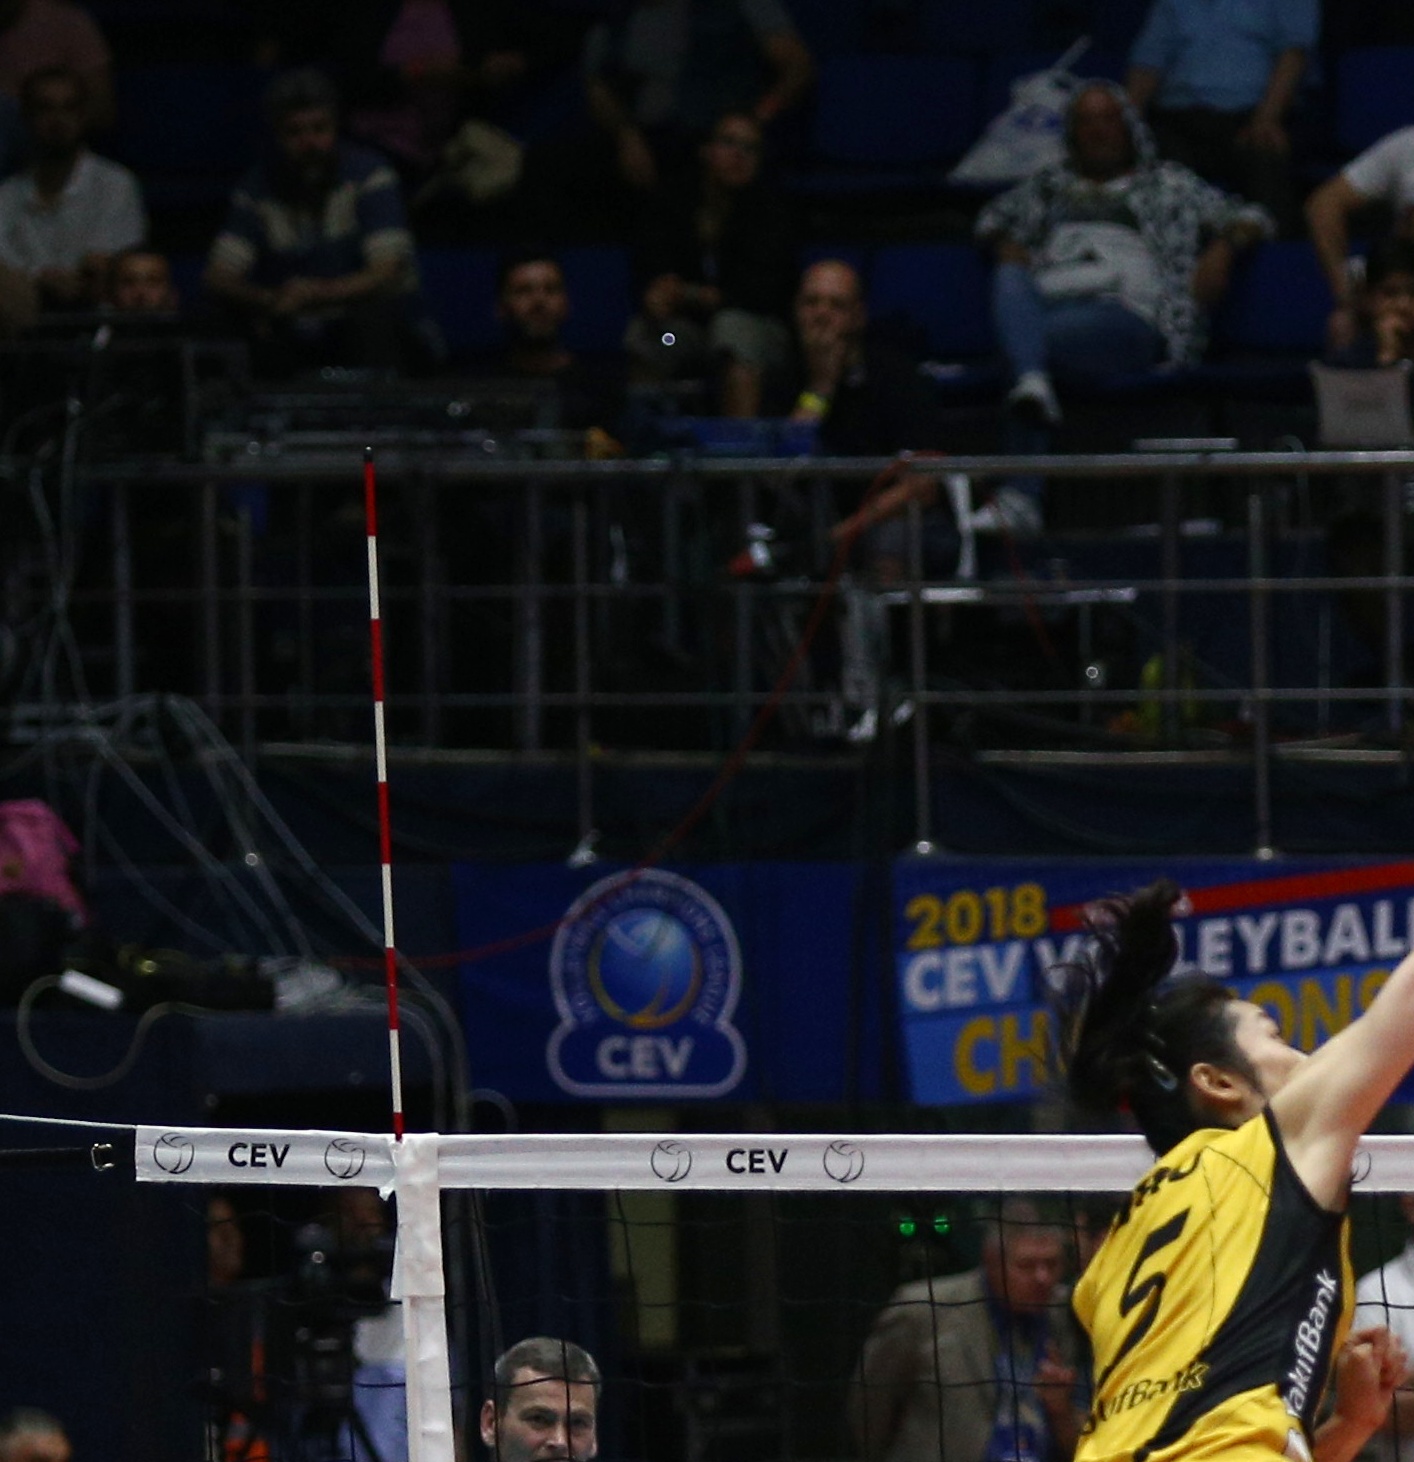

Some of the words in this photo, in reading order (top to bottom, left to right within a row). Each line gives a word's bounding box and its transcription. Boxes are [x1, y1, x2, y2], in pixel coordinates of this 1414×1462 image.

[906, 883, 1048, 951] 2018
[903, 940, 1028, 1013] CEV
[597, 1034, 695, 1079] CEV
[228, 1142, 291, 1169] CEV
[725, 1149, 789, 1175] CEV
[1099, 1206, 1193, 1388] 5
